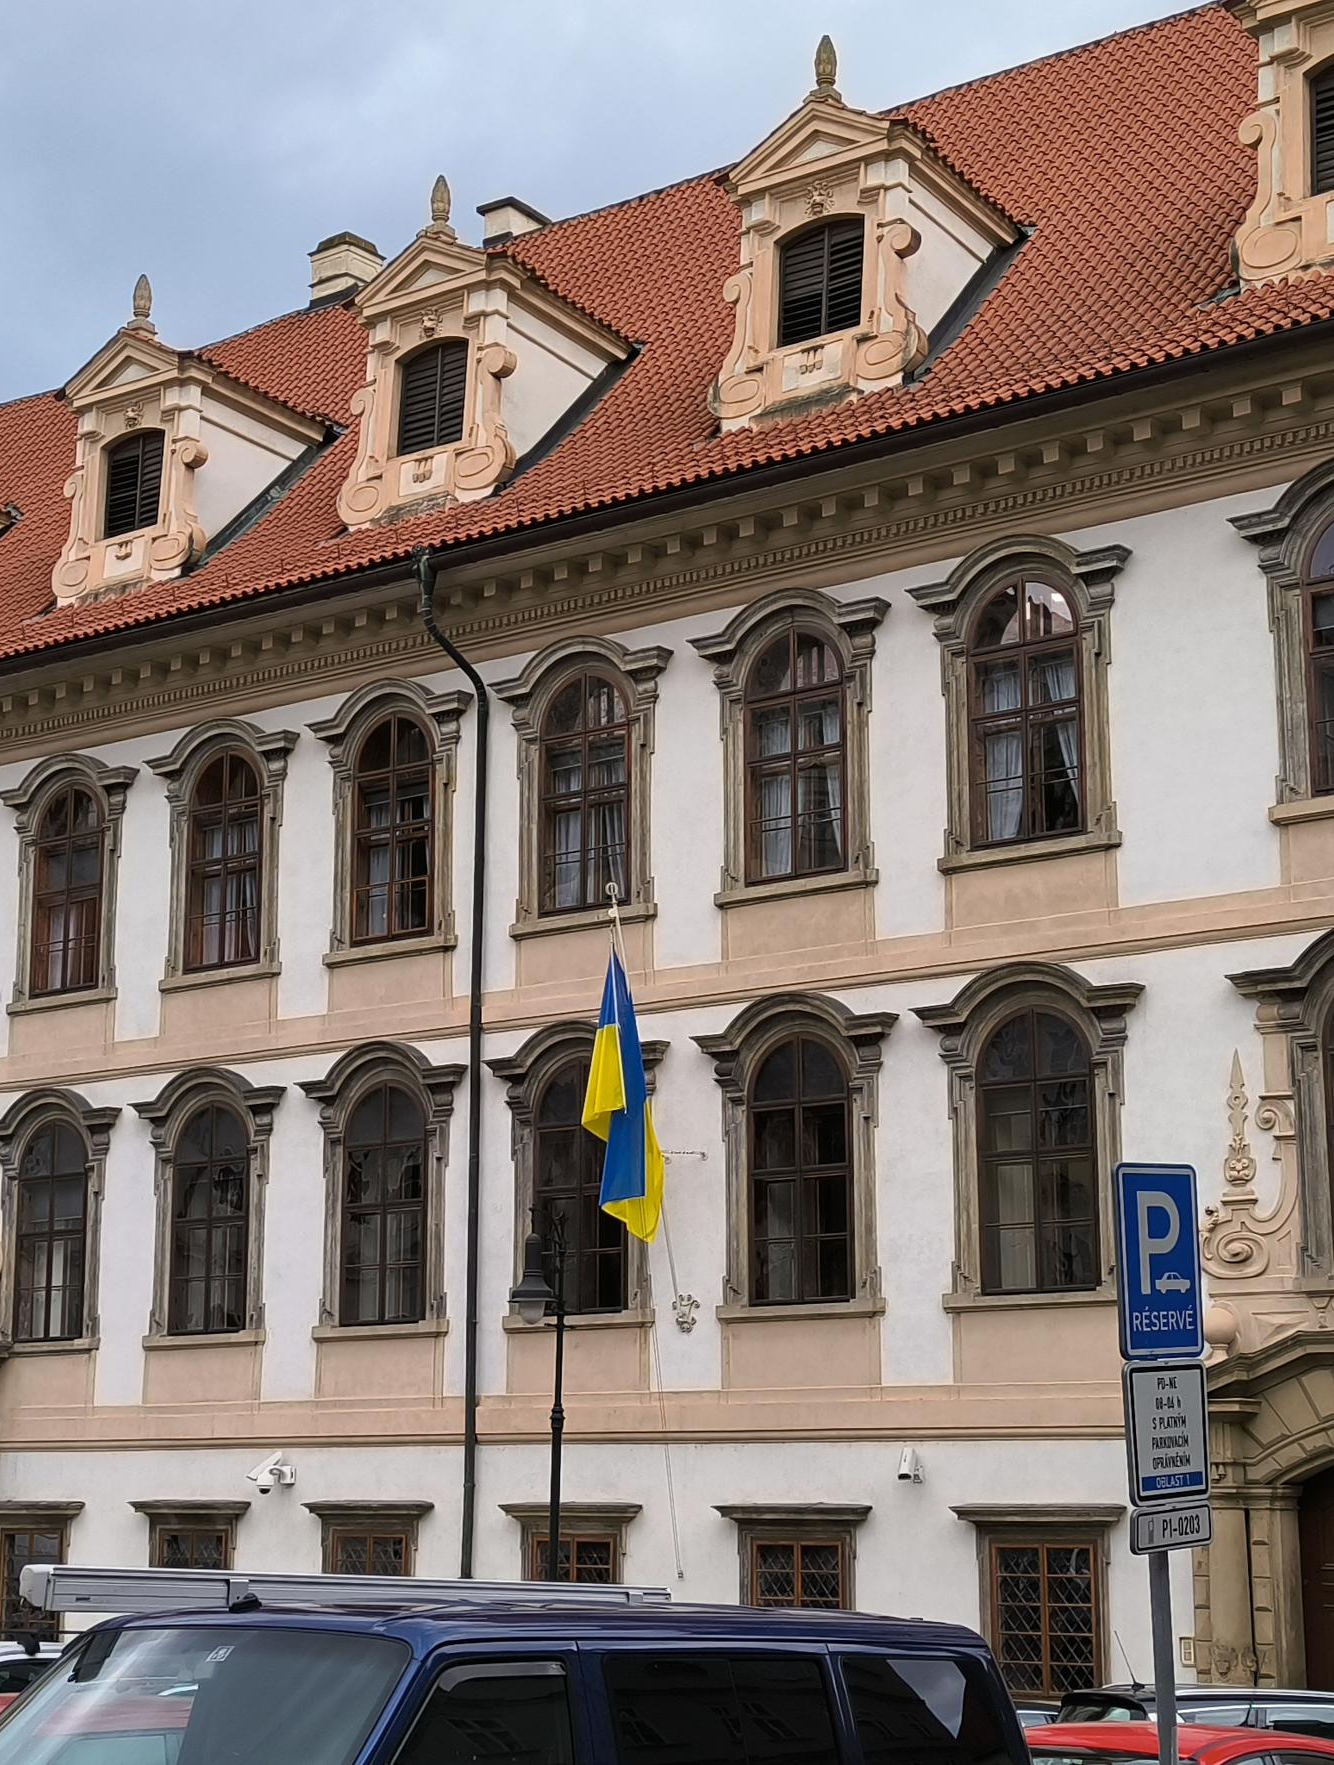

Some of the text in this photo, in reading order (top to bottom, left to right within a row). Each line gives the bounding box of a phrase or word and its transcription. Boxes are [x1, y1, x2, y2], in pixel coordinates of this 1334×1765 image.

[1137, 1190, 1180, 1295] P
[1132, 1304, 1195, 1332] RÉSERVÉ
[1152, 1417, 1157, 1430] S
[1156, 1475, 1183, 1488] OBLAST
[1162, 1514, 1200, 1538] P1-0203
